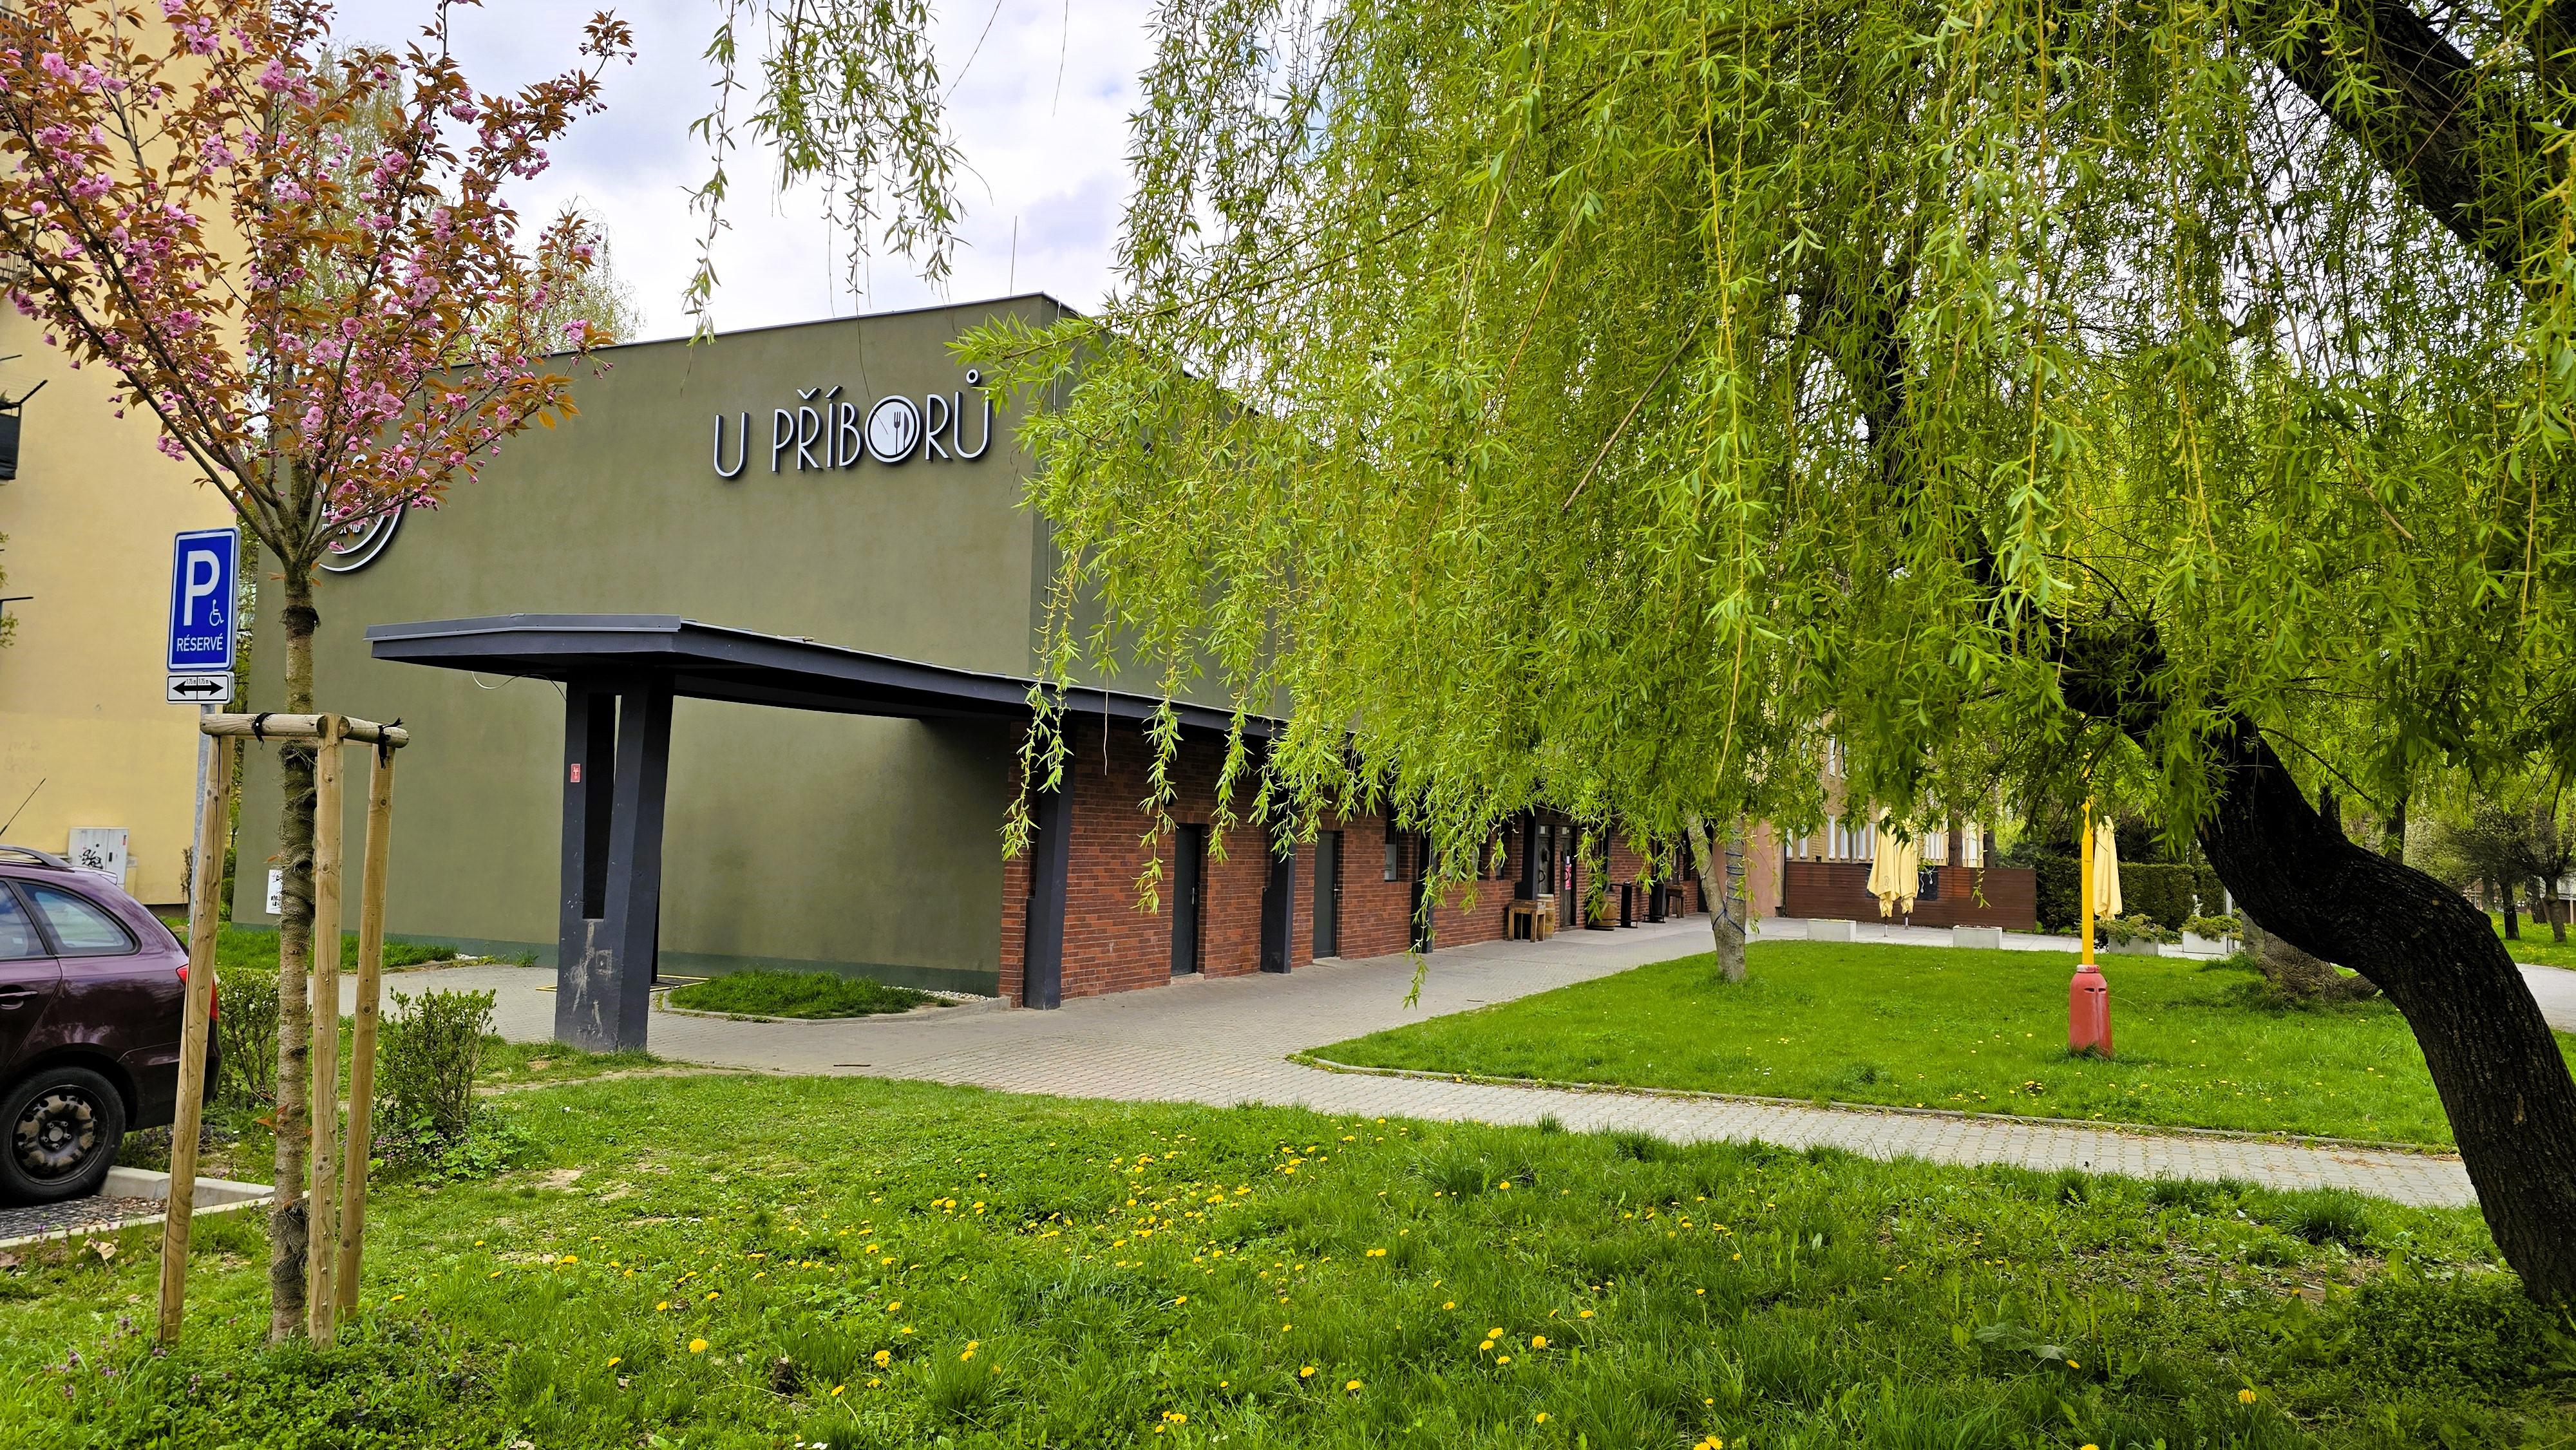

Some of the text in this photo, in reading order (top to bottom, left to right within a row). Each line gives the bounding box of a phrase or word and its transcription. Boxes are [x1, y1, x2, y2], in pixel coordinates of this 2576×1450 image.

[714, 369, 993, 478] U PŘÍBORŮ
[184, 550, 220, 626] P
[176, 633, 223, 652] RÉSERVÉ
